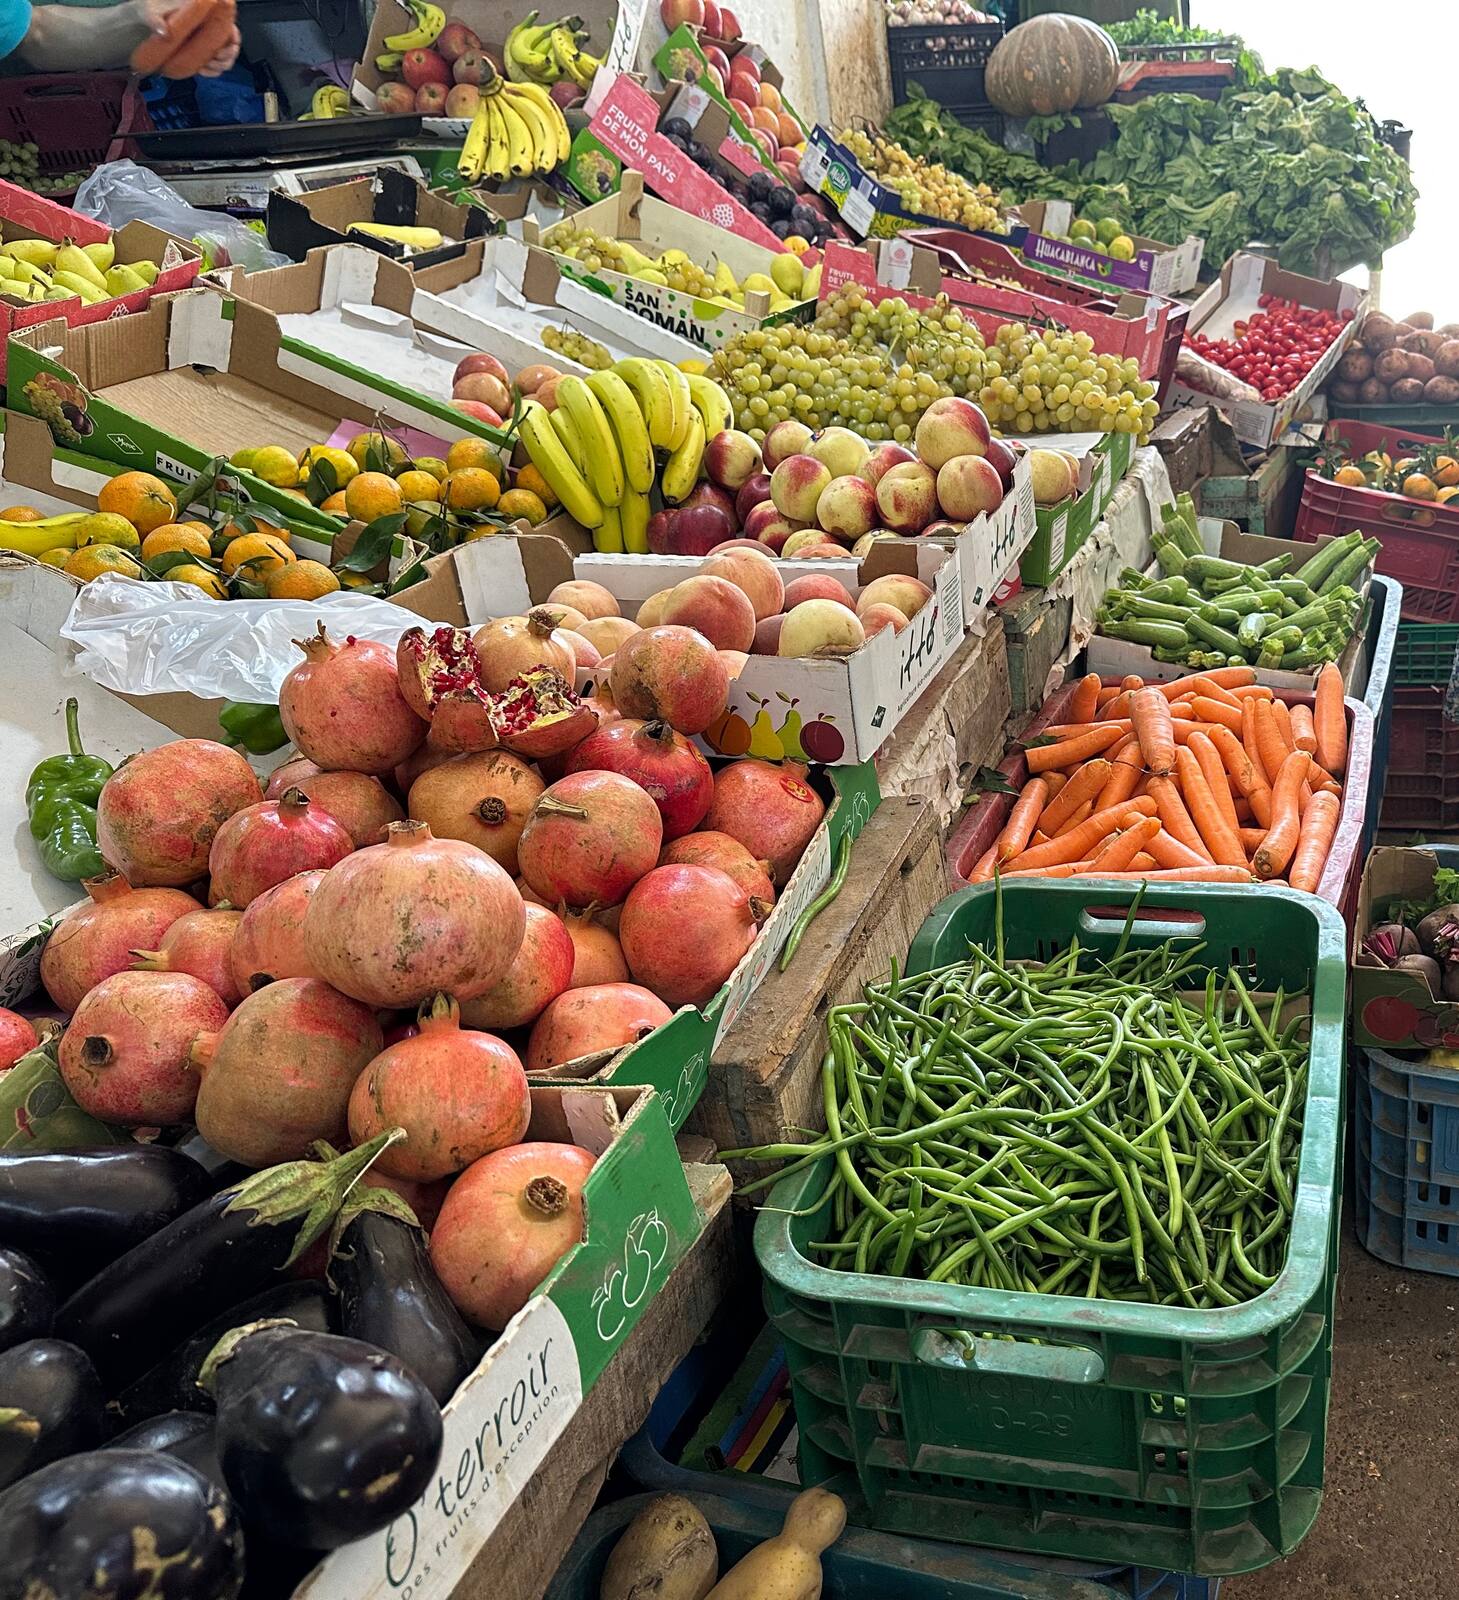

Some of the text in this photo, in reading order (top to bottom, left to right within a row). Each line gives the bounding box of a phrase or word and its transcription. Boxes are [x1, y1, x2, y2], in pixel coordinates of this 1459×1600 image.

[602, 115, 622, 134] DE
[619, 130, 646, 159] MON
[646, 152, 677, 184] PAYS
[607, 104, 649, 144] FRUITS
[625, 287, 660, 310] SAN
[829, 267, 855, 281] FRUITS
[385, 1337, 553, 1588] O'terroir
[400, 1384, 559, 1600] Des fruits d'exception
